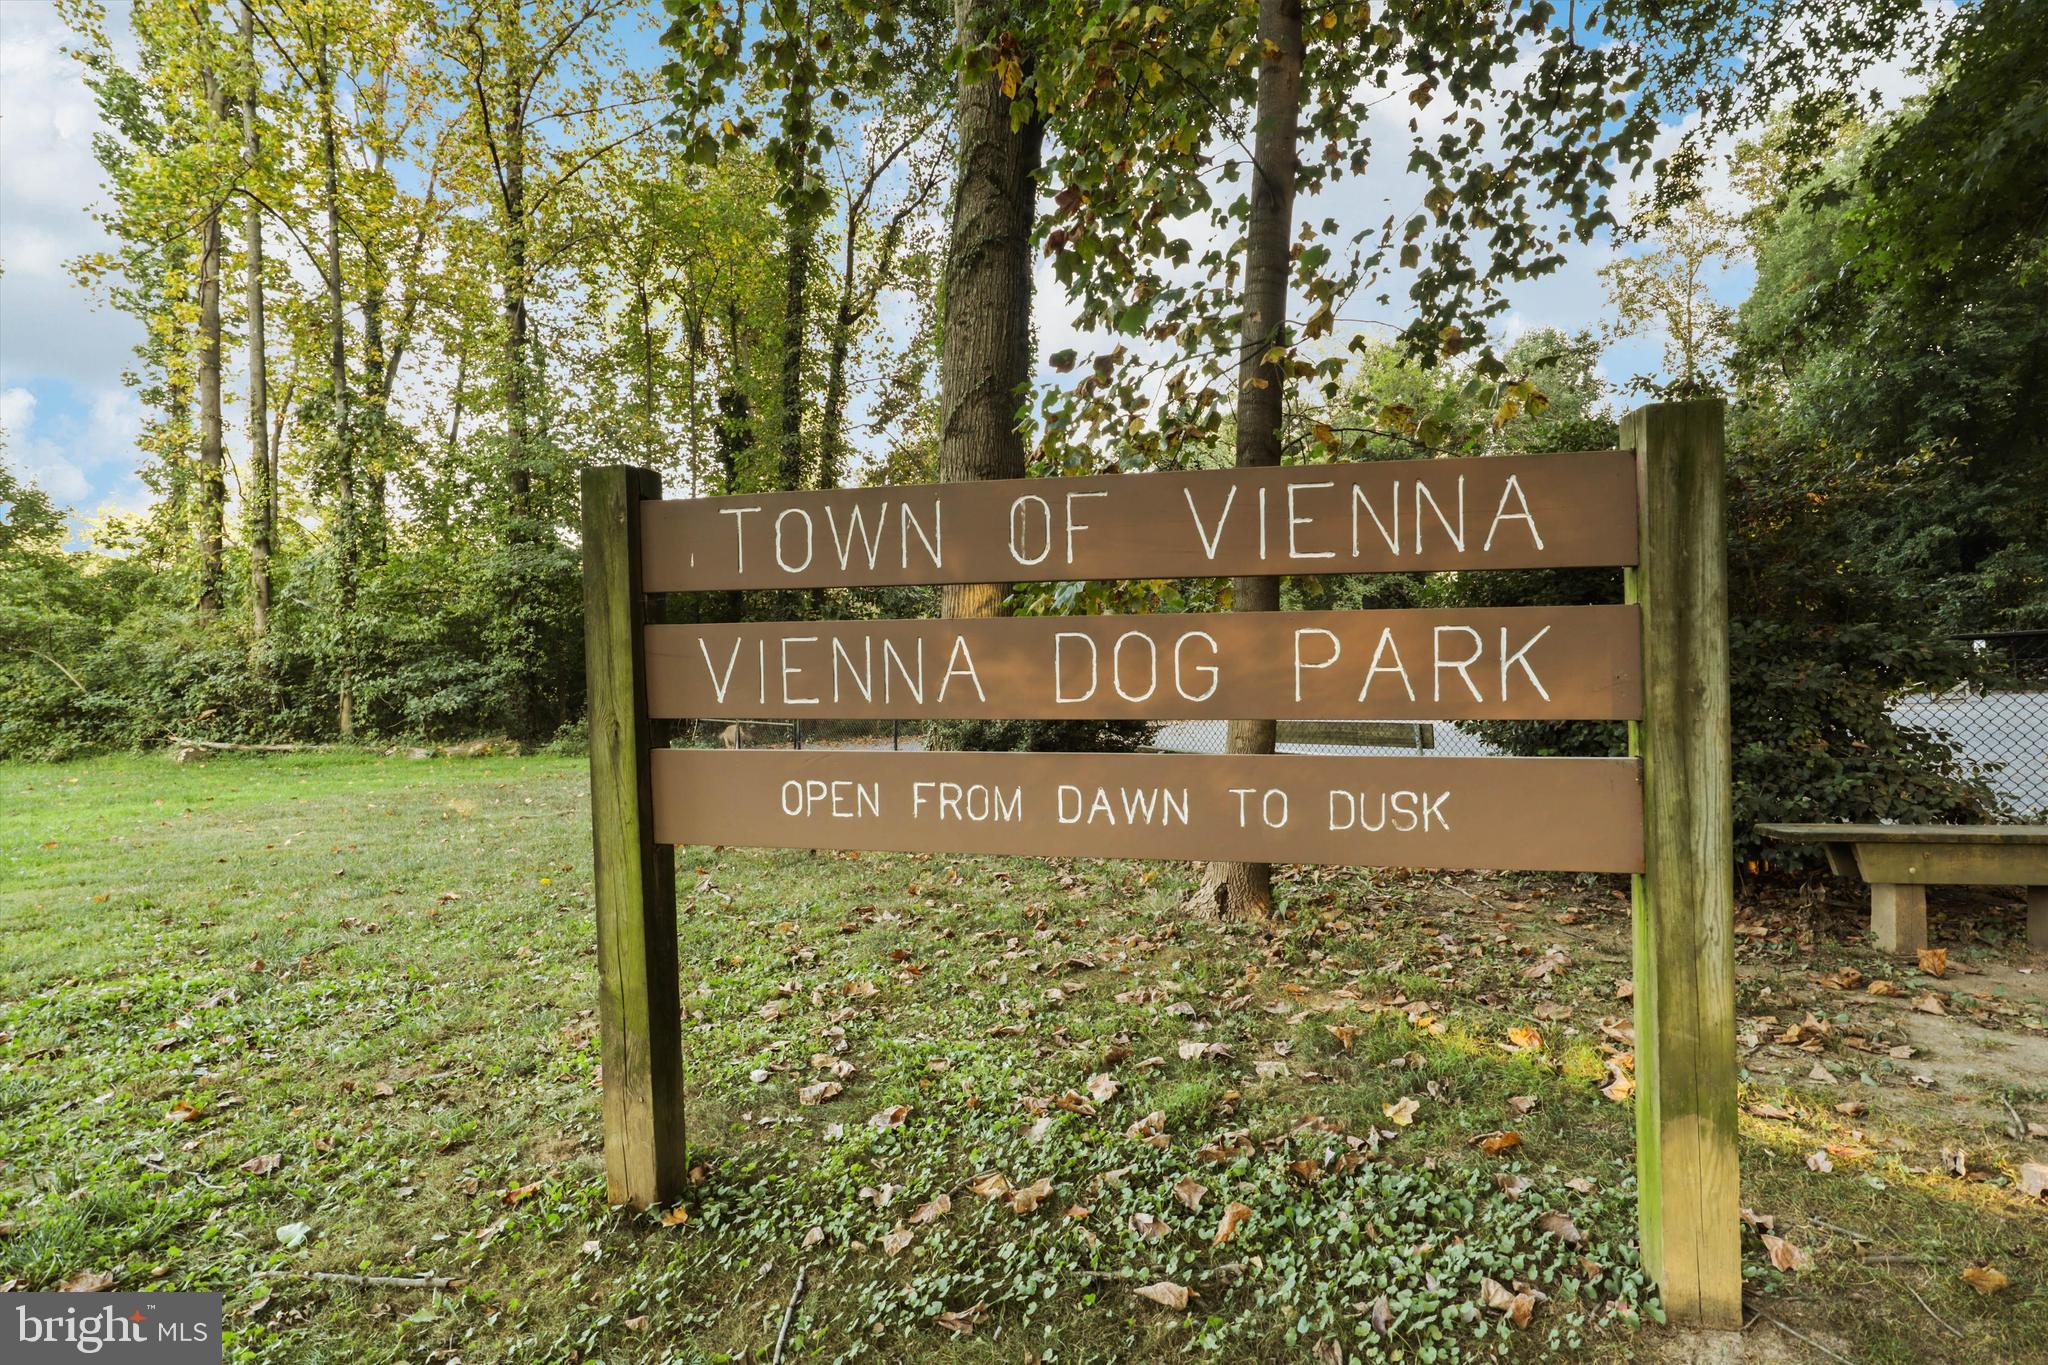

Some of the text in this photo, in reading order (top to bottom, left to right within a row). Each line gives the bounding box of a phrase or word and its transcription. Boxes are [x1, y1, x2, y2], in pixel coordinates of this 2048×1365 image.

[718, 473, 1546, 574] TOWN OF VIENNA
[697, 624, 1552, 705] VIENNA DOG PARK
[781, 779, 1452, 834] OPEN FROM DAWN TO DUSK
